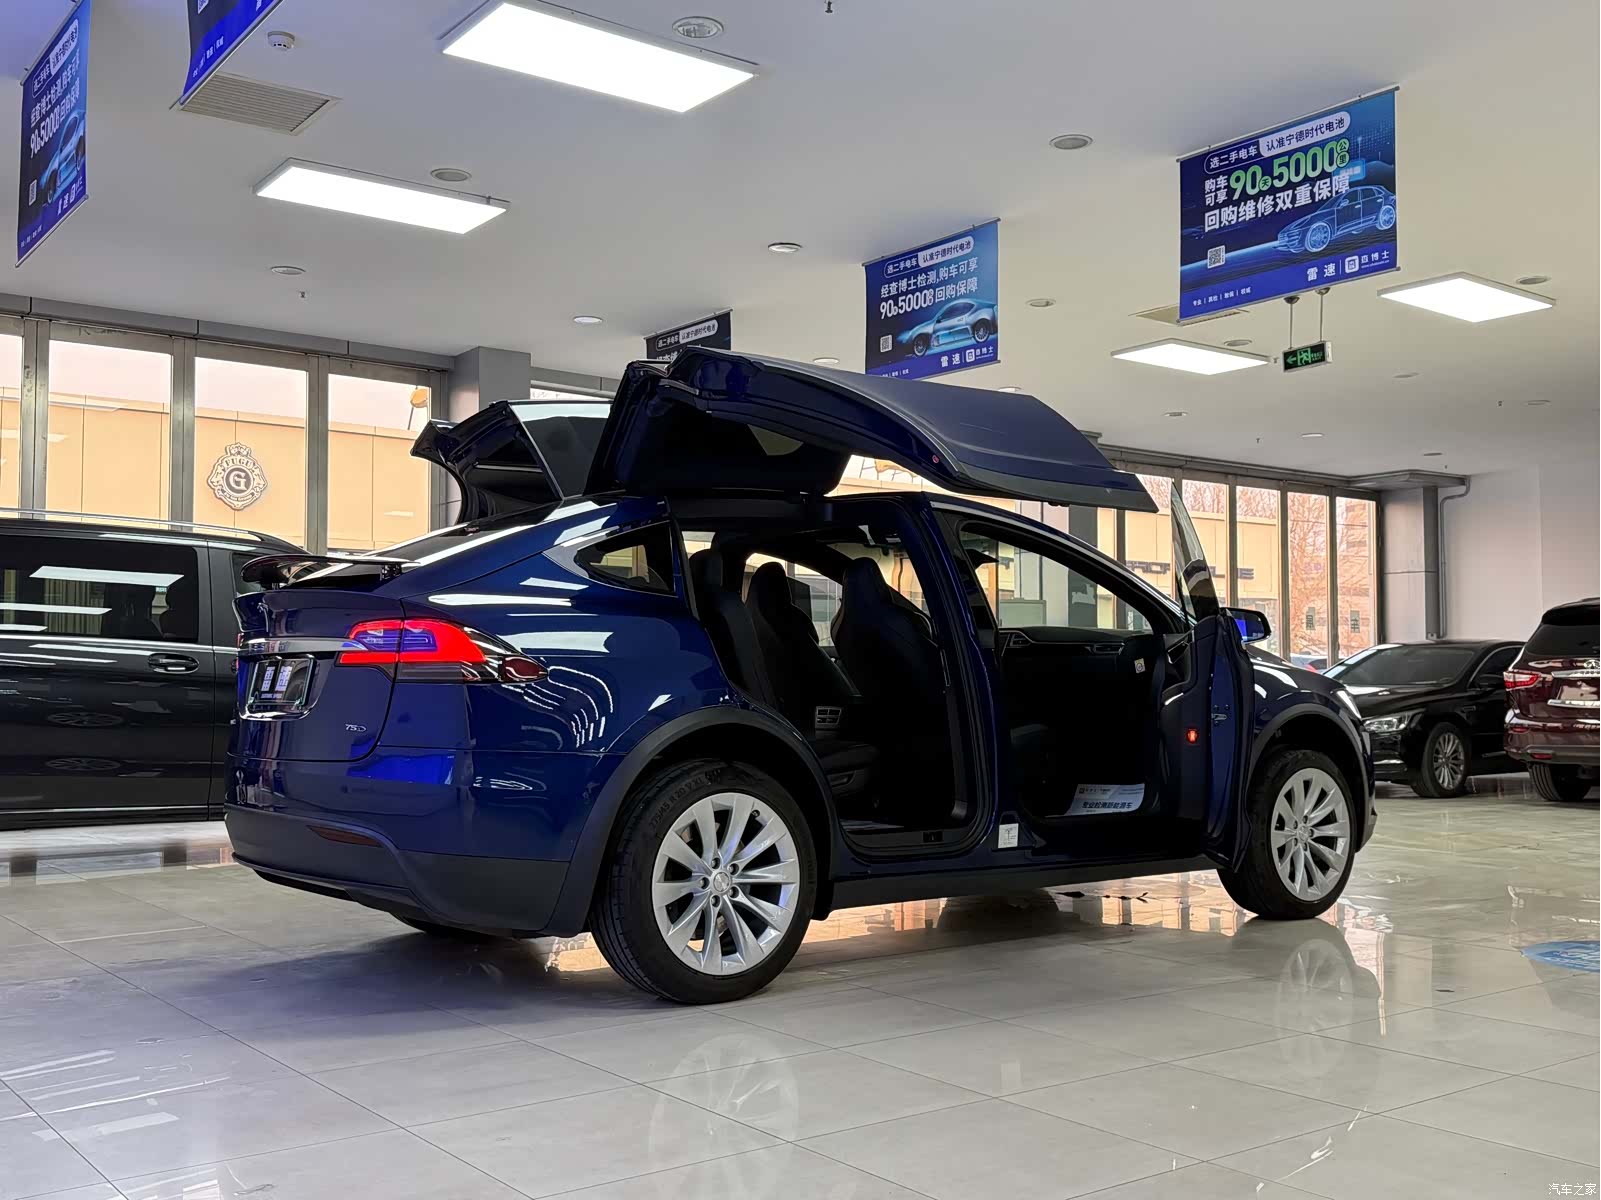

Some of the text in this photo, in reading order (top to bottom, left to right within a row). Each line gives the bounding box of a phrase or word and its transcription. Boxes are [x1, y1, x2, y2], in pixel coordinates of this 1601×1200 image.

[1209, 117, 1345, 170] 选二手电车 认准宁德时代电池
[1204, 175, 1228, 193] 购车
[1204, 189, 1228, 207] 可享
[1204, 174, 1350, 233] 回购维修双重保障
[887, 257, 918, 274] 选二手电车
[345, 723, 367, 732] 75D
